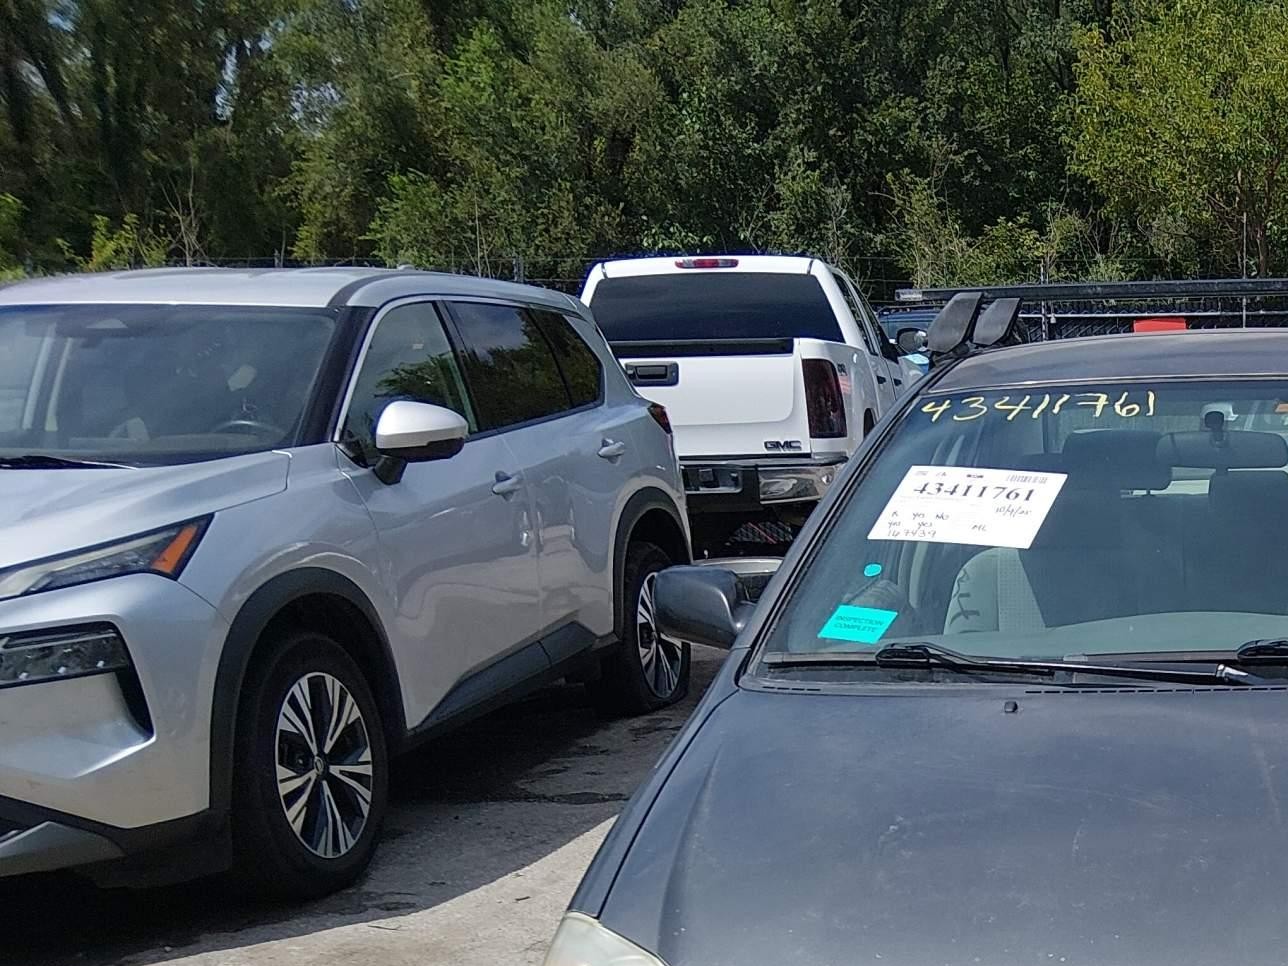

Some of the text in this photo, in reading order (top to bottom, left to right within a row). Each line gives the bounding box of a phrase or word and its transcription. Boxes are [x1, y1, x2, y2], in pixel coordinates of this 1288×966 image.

[921, 390, 1155, 422] 43411761
[763, 440, 802, 450] GMC
[913, 481, 1036, 502] 43411761
[835, 615, 885, 626] INSPECTION
[833, 623, 879, 633] COMPLETE
